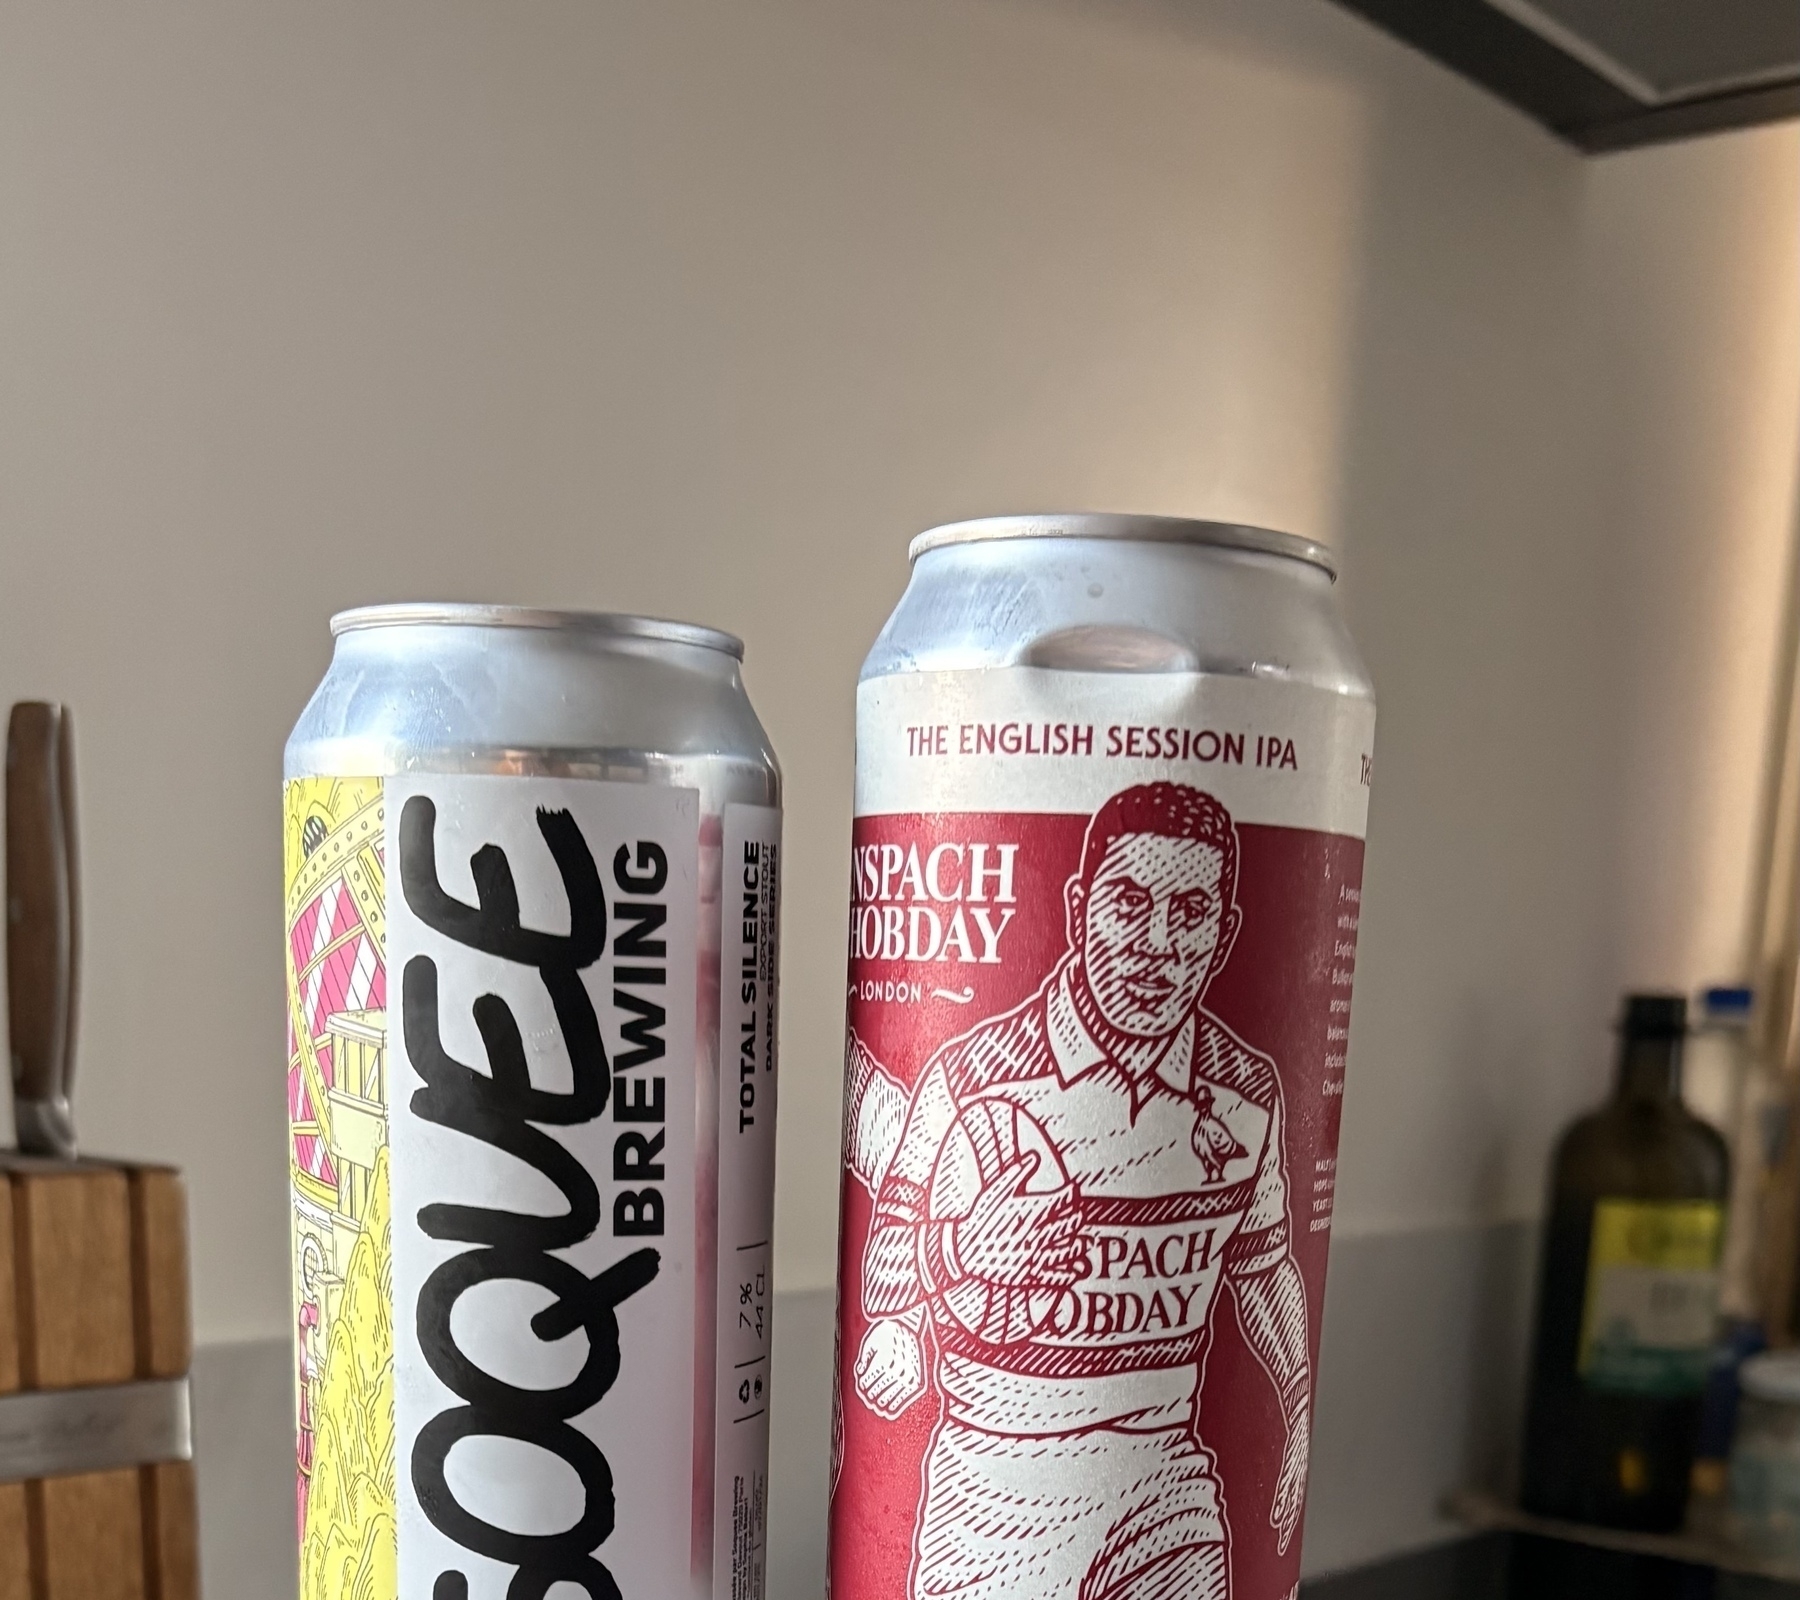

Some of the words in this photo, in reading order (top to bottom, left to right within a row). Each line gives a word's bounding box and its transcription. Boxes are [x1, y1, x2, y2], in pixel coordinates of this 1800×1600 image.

[907, 725, 949, 757] THE
[959, 723, 1094, 757] ENGLISH
[1106, 725, 1247, 765] SESSION
[1256, 736, 1298, 771] IPA
[761, 840, 769, 905] STOUT
[768, 843, 777, 936] SERIES
[851, 840, 1020, 904] NSPACH
[741, 840, 760, 1005] SILENCE
[760, 907, 768, 981] EXPORT
[767, 940, 775, 999] SIDE
[860, 980, 922, 1004] LONDON
[613, 840, 668, 1237] BREWING
[739, 1010, 756, 1134] TOTAL
[756, 1264, 765, 1297] CL
[739, 1311, 752, 1329] 7
[755, 1305, 764, 1340] 44
